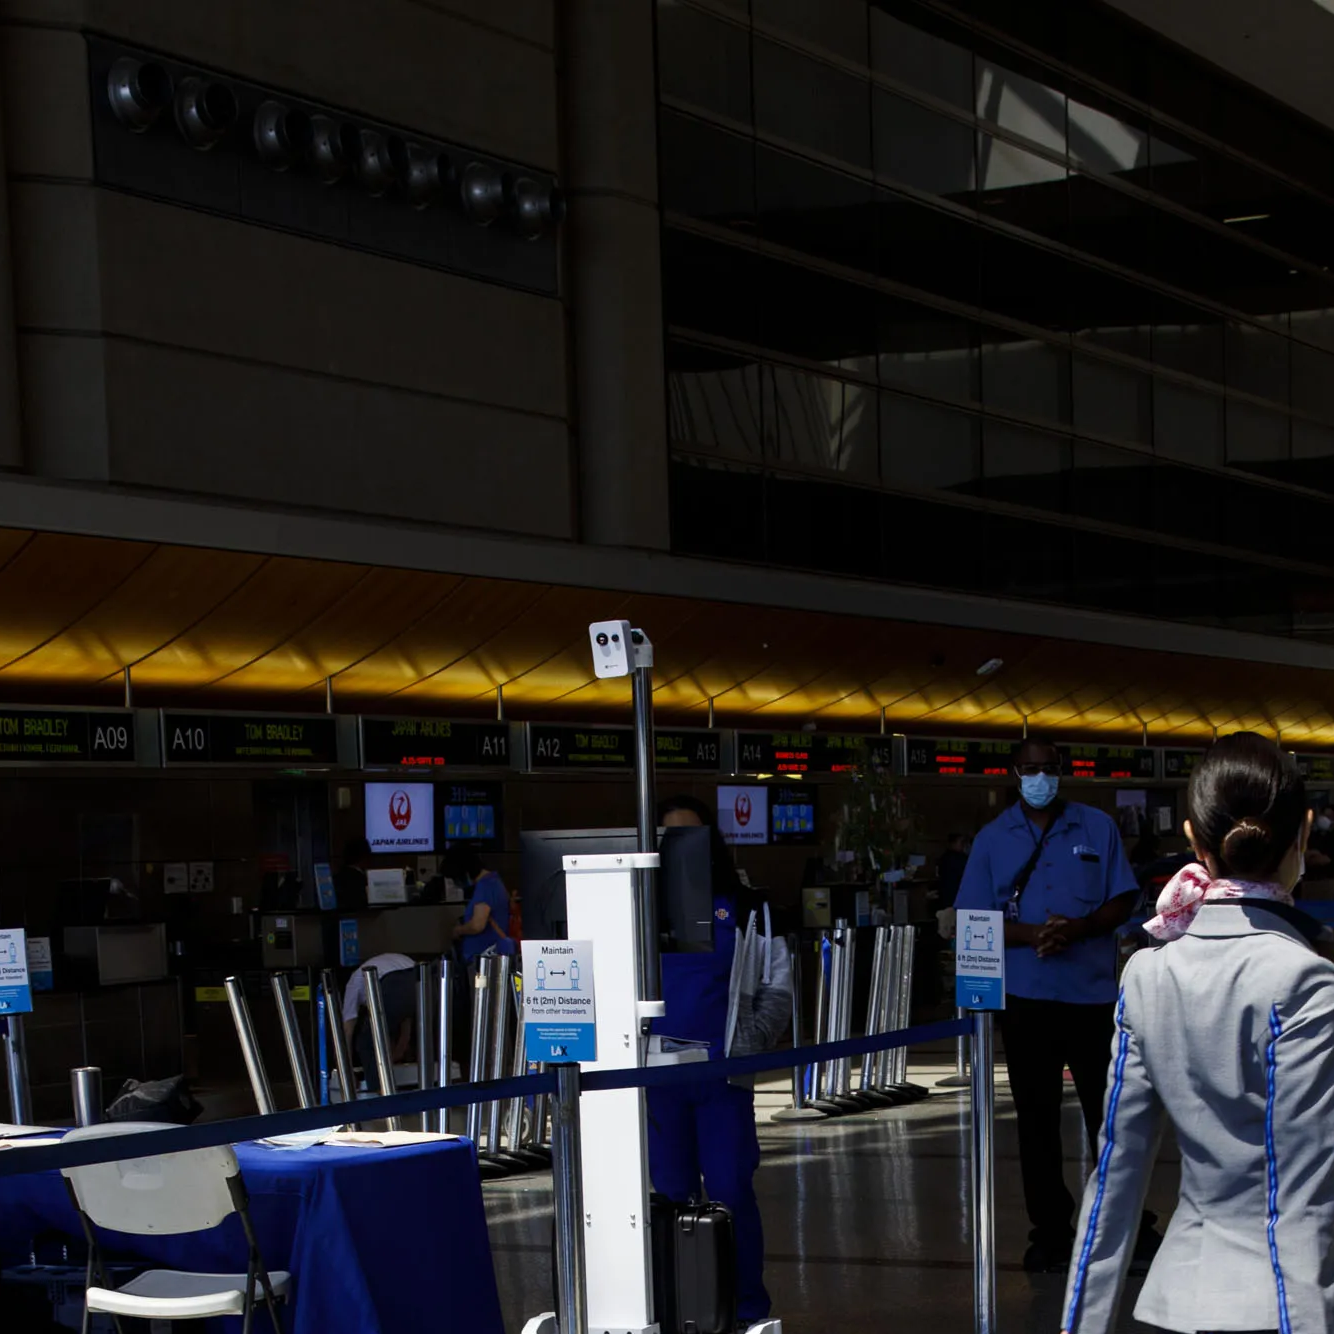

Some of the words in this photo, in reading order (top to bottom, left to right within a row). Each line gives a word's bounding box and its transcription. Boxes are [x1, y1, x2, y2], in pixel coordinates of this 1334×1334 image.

[23, 717, 68, 737] BRADLEY
[244, 722, 263, 741] TOM
[266, 723, 304, 741] BRADLEY
[94, 725, 128, 751] A09
[172, 727, 205, 752] A10
[482, 736, 506, 756] A11
[537, 737, 561, 758] A12
[697, 742, 717, 761] A13
[741, 742, 762, 762] A14
[396, 837, 429, 845] AIRLINES
[541, 946, 574, 955] Maintain
[533, 996, 539, 1005] ft
[540, 997, 556, 1006] (2m)
[558, 996, 591, 1005] Distance
[550, 1044, 568, 1057] LAX
